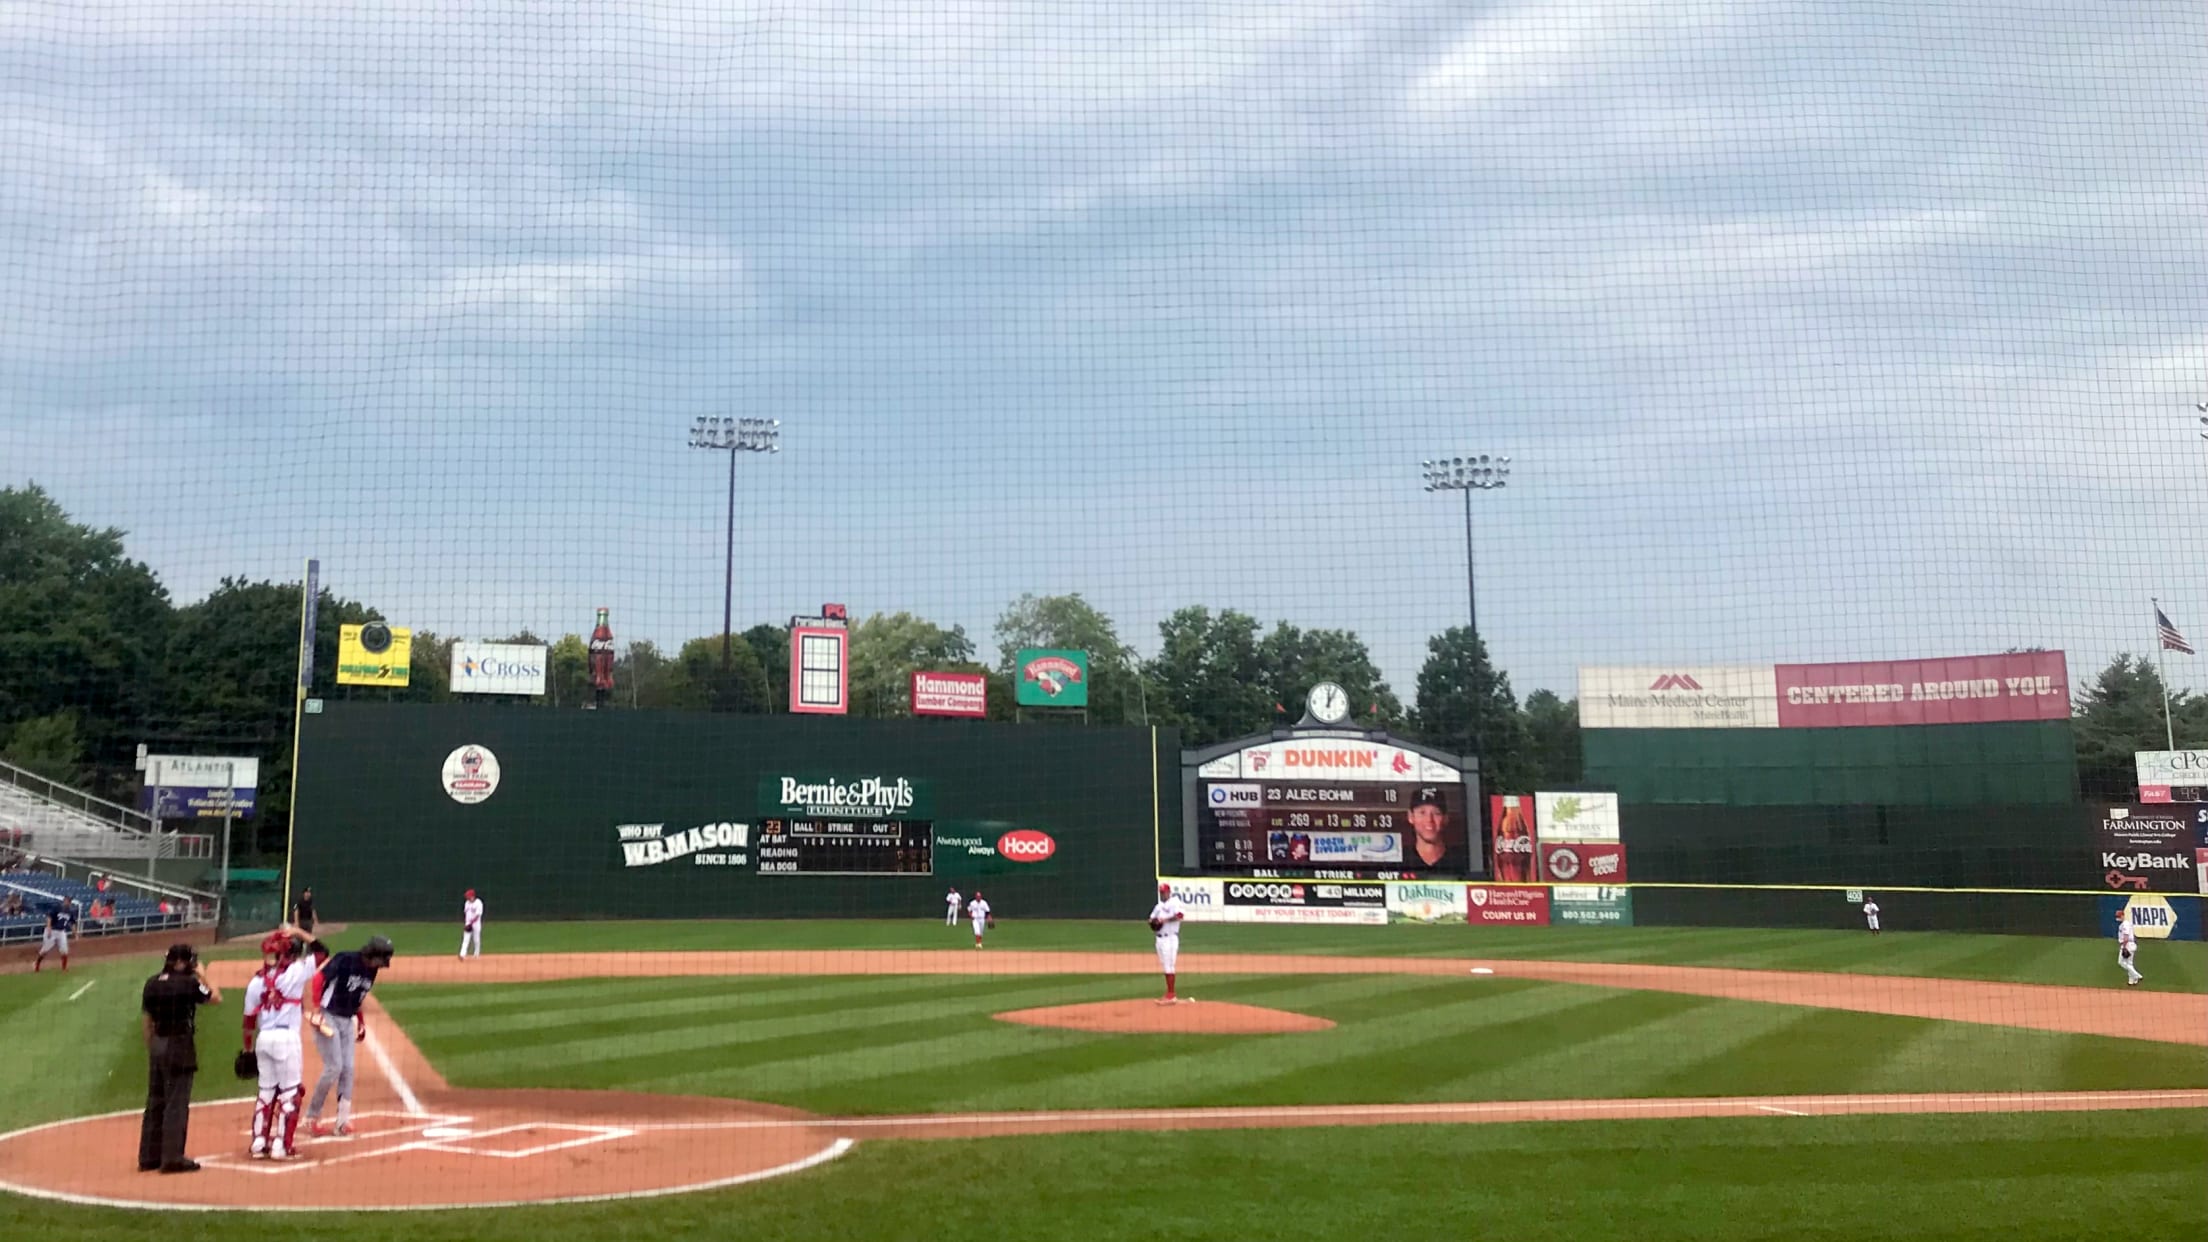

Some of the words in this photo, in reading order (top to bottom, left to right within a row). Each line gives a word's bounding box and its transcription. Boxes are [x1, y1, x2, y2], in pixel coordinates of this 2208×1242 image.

[915, 675, 985, 695] Hammond
[1787, 684, 1904, 705] CENTERED
[1911, 678, 1999, 701] AROUND
[2005, 676, 2059, 696] YOU.
[917, 695, 944, 706] Lumber
[945, 696, 983, 711] Company
[1608, 693, 1648, 708] Maine
[1650, 693, 1701, 708] Medical
[1705, 694, 1748, 708] Center
[1285, 750, 1378, 768] DUNKIN'
[1230, 792, 1259, 802] HUB
[1267, 789, 1281, 800] 23
[1286, 789, 1317, 801] ALEC
[1319, 790, 1354, 801] BOHM
[808, 807, 882, 816] FURNITURE
[766, 820, 781, 833] 23
[1327, 814, 1338, 827] 13
[1353, 814, 1366, 828] 36
[1379, 815, 1392, 828] 33
[2103, 819, 2186, 830] FARMINGTON
[794, 823, 813, 832] BALL
[828, 823, 853, 833] STRIKE
[873, 824, 888, 833] OUT
[760, 835, 770, 843] AT
[772, 835, 787, 844] BAT
[936, 836, 961, 847] Always
[1005, 837, 1049, 854] Hood
[695, 853, 726, 865] SINCE
[760, 848, 798, 858] READING
[760, 861, 775, 871] SEA
[776, 861, 797, 871] DOGS
[2102, 852, 2189, 871] KeyBank
[1253, 869, 1280, 878] BALL
[1315, 870, 1354, 879] STRIKE
[1377, 871, 1400, 880] OUT
[1343, 887, 1383, 898] MILLION
[1398, 885, 1454, 904] Oakhurst
[1255, 908, 1273, 917] BUY
[1274, 908, 1295, 917] YOUR
[1297, 909, 1325, 917] TICKET
[1482, 910, 1512, 920] COUNT
[1513, 911, 1525, 920] US
[1526, 912, 1537, 921] IN
[2131, 907, 2168, 926] NAPA
